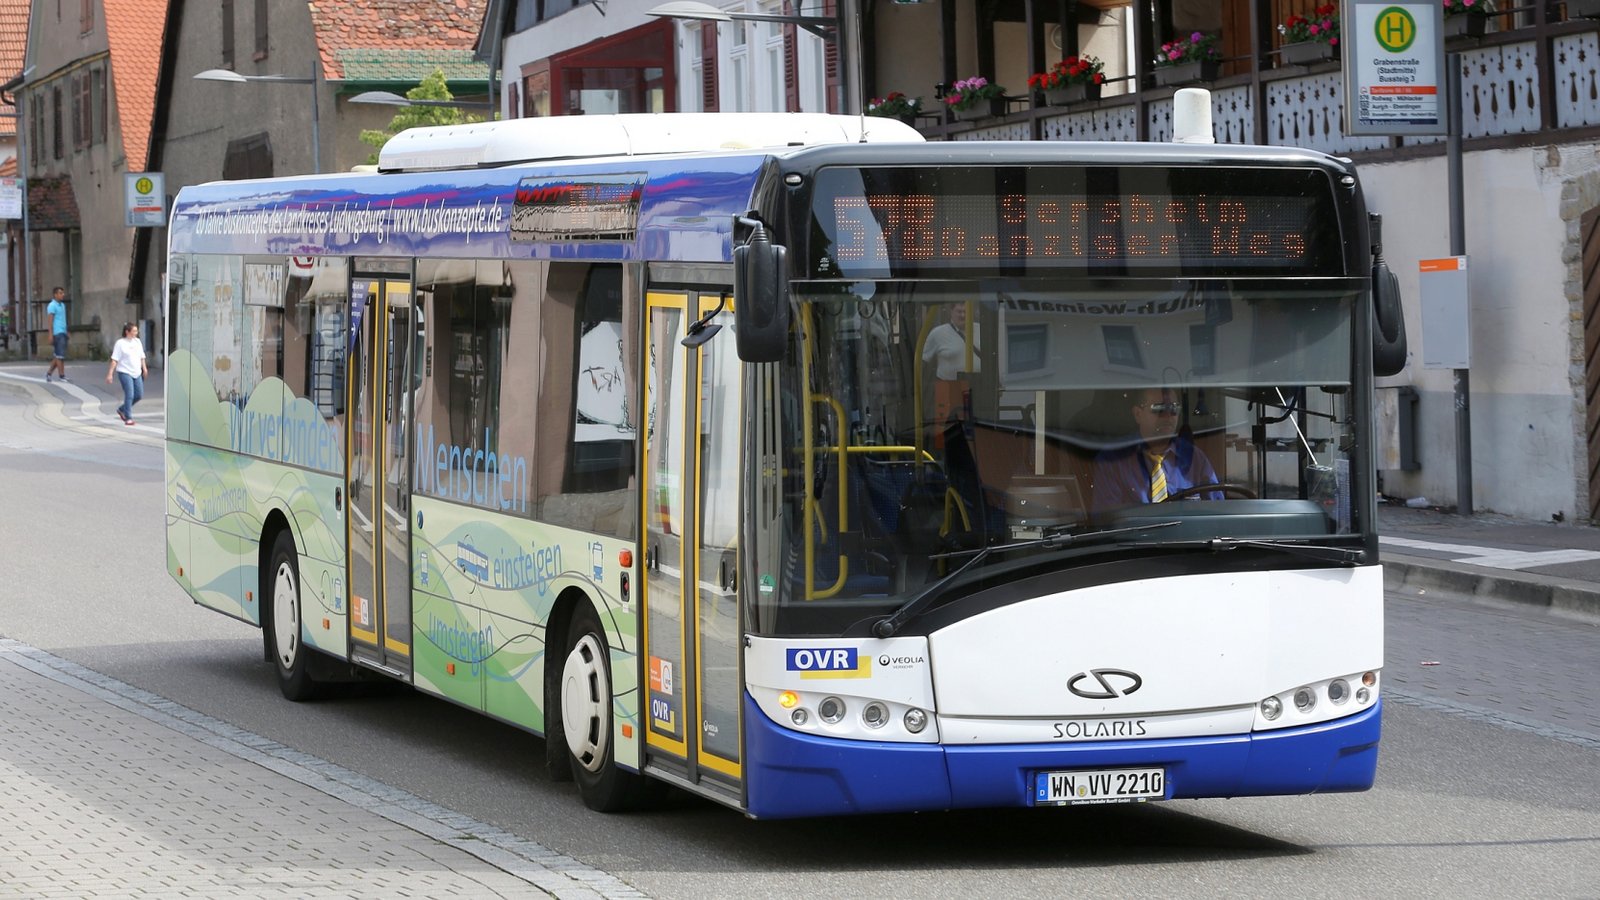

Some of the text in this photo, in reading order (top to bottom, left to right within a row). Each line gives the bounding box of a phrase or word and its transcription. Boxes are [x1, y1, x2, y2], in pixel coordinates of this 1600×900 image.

[1386, 15, 1405, 43] H
[1373, 58, 1420, 66] Grabenstraße
[1377, 66, 1417, 75] (Stadtmitte)
[1379, 75, 1409, 84] Bussteig
[204, 207, 224, 234] Jahre
[223, 206, 269, 243] Buskonzepte
[269, 204, 282, 234] des
[282, 202, 329, 234] Landkreises
[329, 200, 386, 244] Ludwigsburg
[393, 196, 502, 244] www.buskonzepte.de
[833, 194, 1247, 260] 578 Sersheim
[942, 226, 1305, 259] Danziger Weg
[229, 393, 527, 513] Wir verbinden Menschen
[493, 540, 562, 597] einsteigen
[428, 611, 494, 677] umsteigen
[794, 649, 849, 670] OVR
[891, 656, 925, 664] VEOLIA
[652, 698, 669, 721] OVR
[1053, 720, 1146, 738] SOLARIS
[1040, 789, 1046, 797] D
[1051, 772, 1162, 798] WN VV 2210
